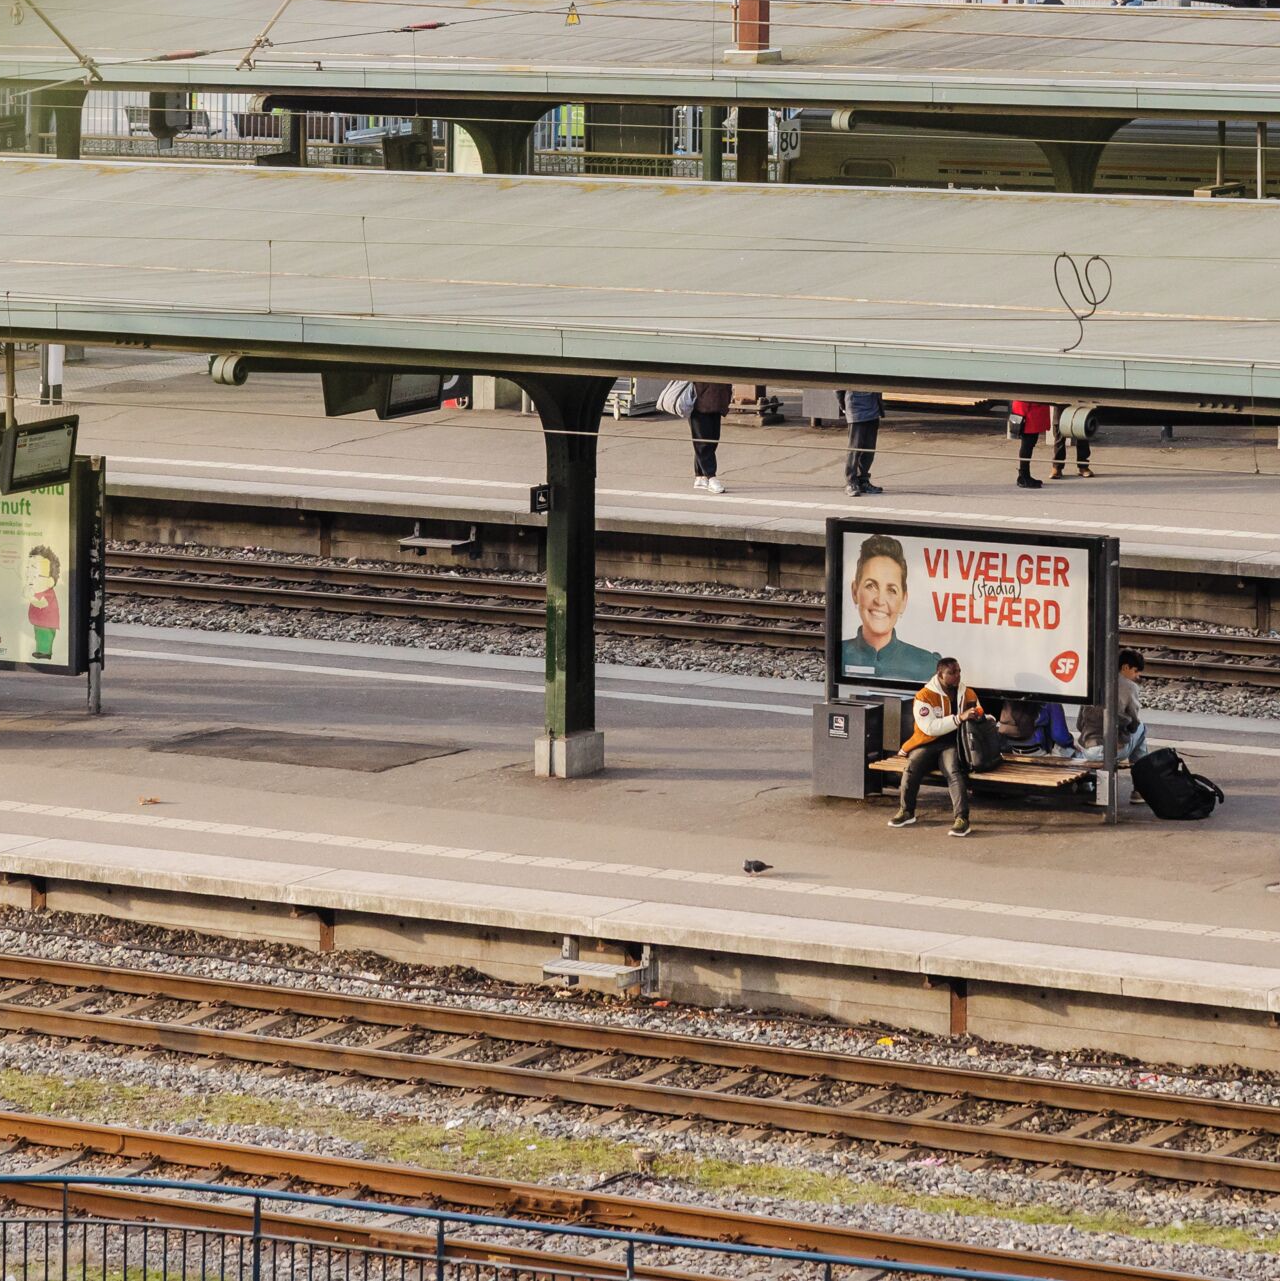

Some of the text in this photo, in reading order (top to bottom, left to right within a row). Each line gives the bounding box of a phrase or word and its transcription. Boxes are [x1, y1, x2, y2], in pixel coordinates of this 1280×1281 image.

[780, 130, 799, 153] 80
[923, 548, 1070, 587] VI VÆLGER
[971, 576, 1022, 602] (stadig)
[932, 591, 1061, 630] VELFÆRD
[1055, 657, 1076, 675] SF
